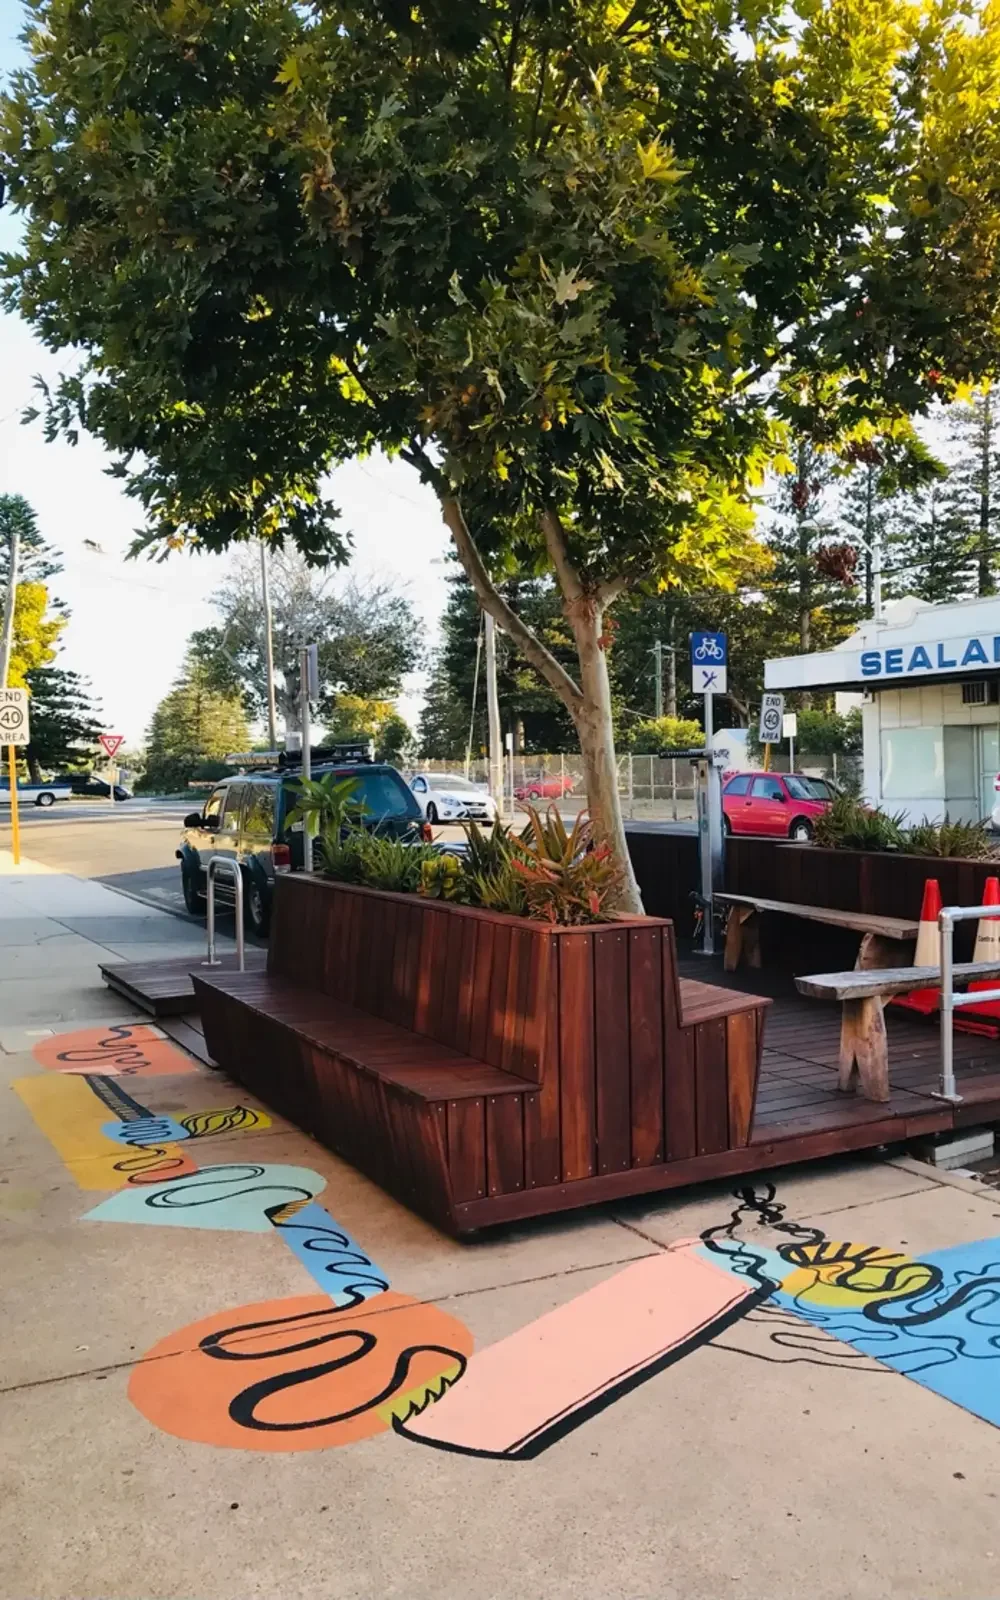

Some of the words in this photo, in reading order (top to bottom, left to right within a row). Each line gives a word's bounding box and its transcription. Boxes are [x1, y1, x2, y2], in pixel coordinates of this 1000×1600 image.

[766, 697, 781, 706] END
[1, 711, 21, 723] 40
[765, 714, 778, 725] 40
[762, 732, 779, 741] AREA
